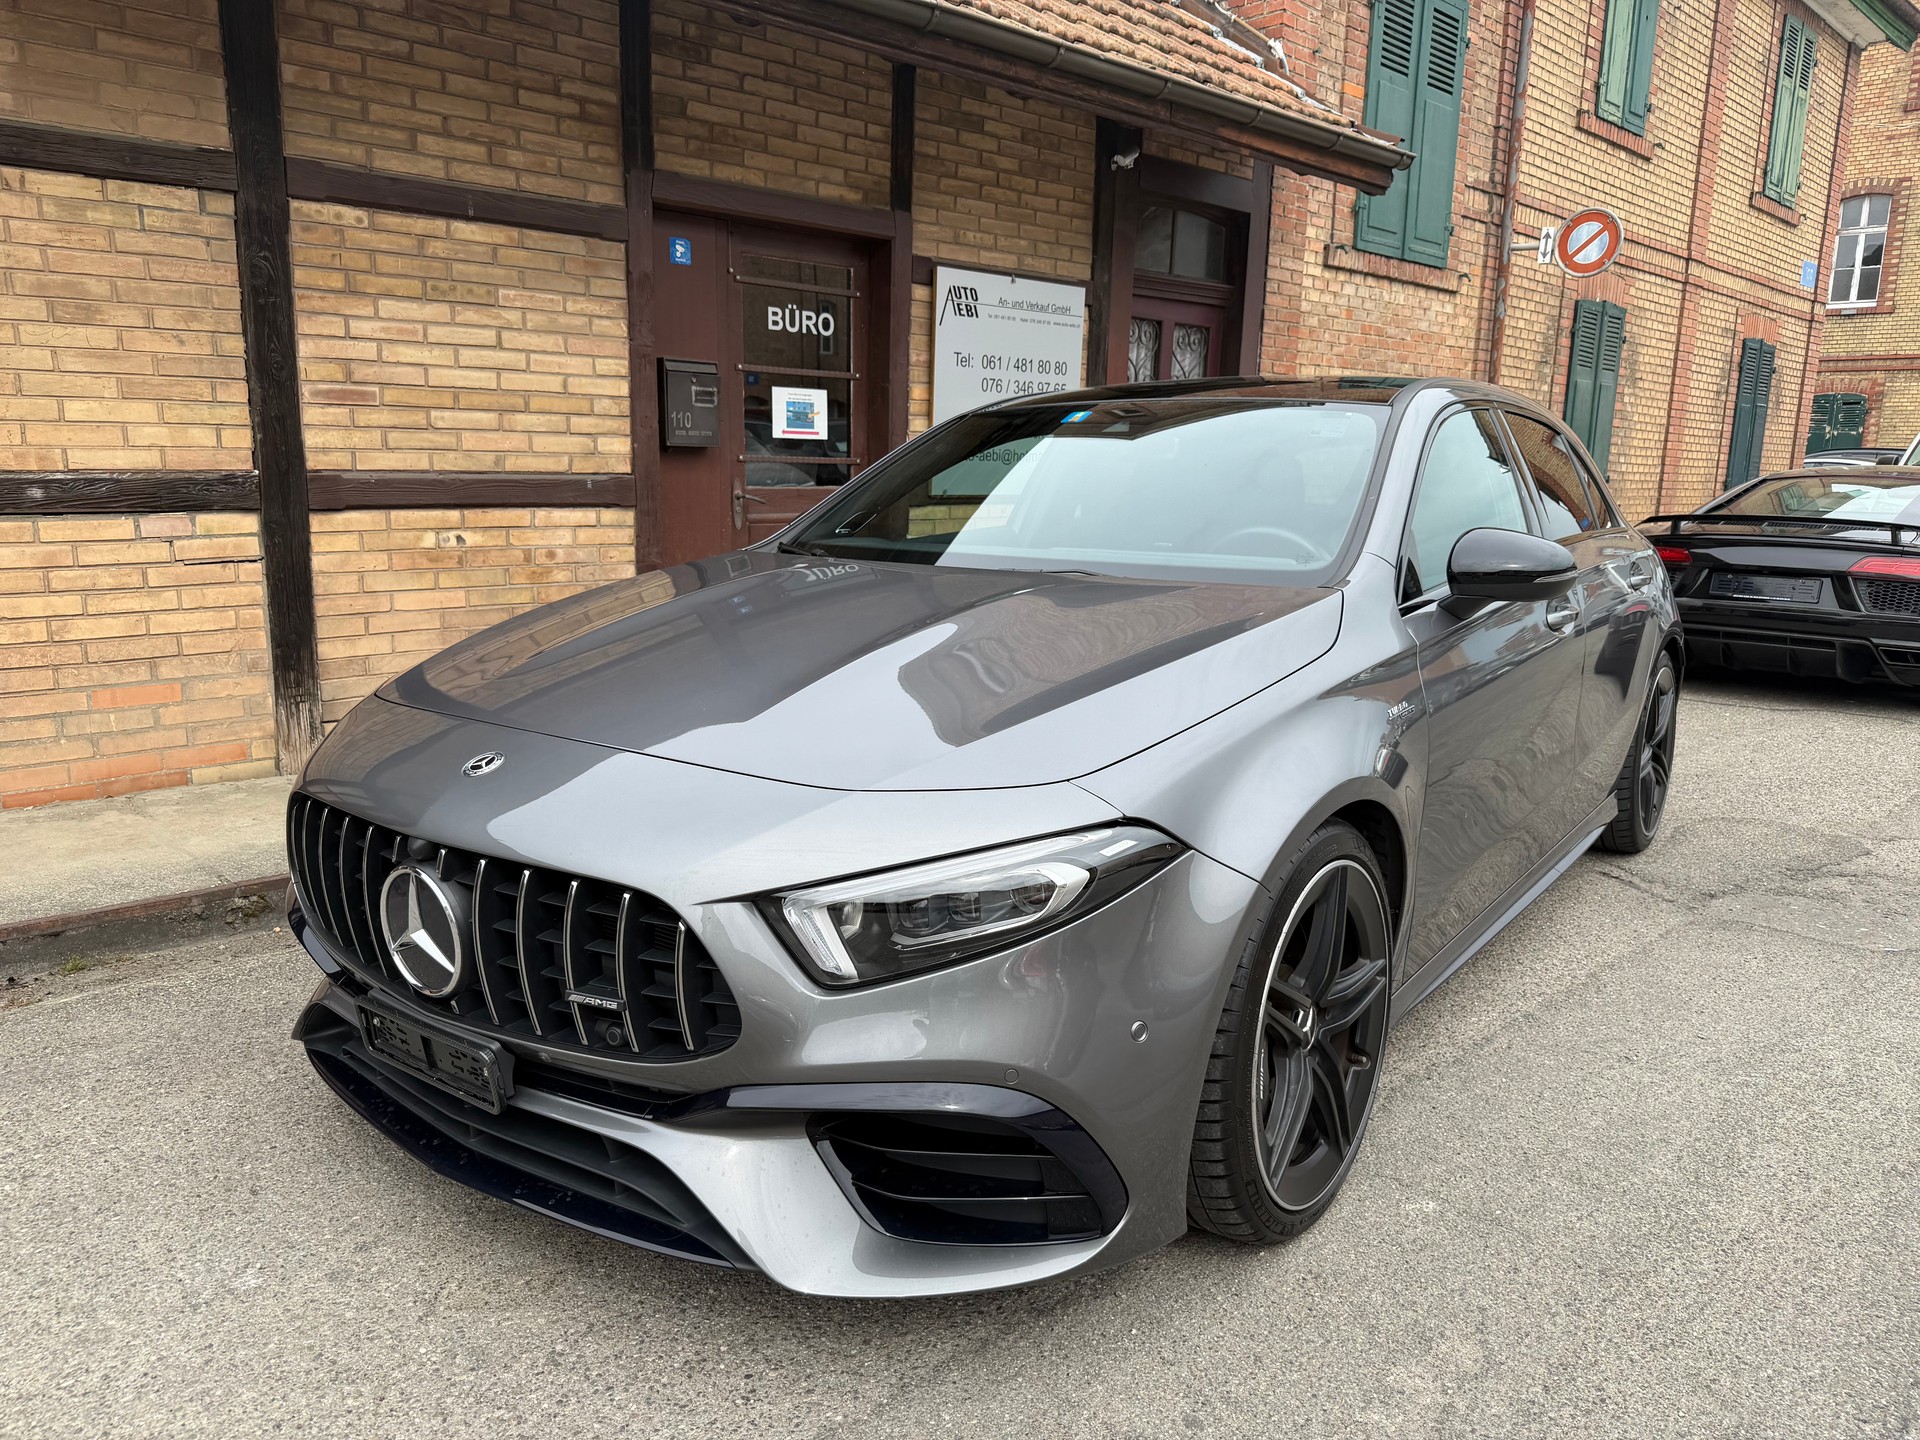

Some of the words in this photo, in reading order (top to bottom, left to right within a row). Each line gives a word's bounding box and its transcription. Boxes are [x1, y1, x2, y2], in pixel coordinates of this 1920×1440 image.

[998, 297, 1010, 306] An-
[1012, 300, 1024, 308] und
[1026, 300, 1050, 312] Verkauf
[1050, 304, 1071, 315] GmbH
[768, 304, 835, 337] BÜRO
[954, 352, 974, 368] Tel:
[982, 354, 1002, 370] 061
[1006, 357, 1011, 371] /
[1013, 358, 1033, 373] 481
[1038, 360, 1051, 374] 80
[1054, 361, 1068, 376] 80
[982, 378, 1002, 394] 076
[1006, 380, 1010, 394] /
[1013, 380, 1034, 395] 346
[1038, 382, 1050, 393] 97
[671, 411, 692, 428] 110
[583, 996, 618, 1010] AMG
